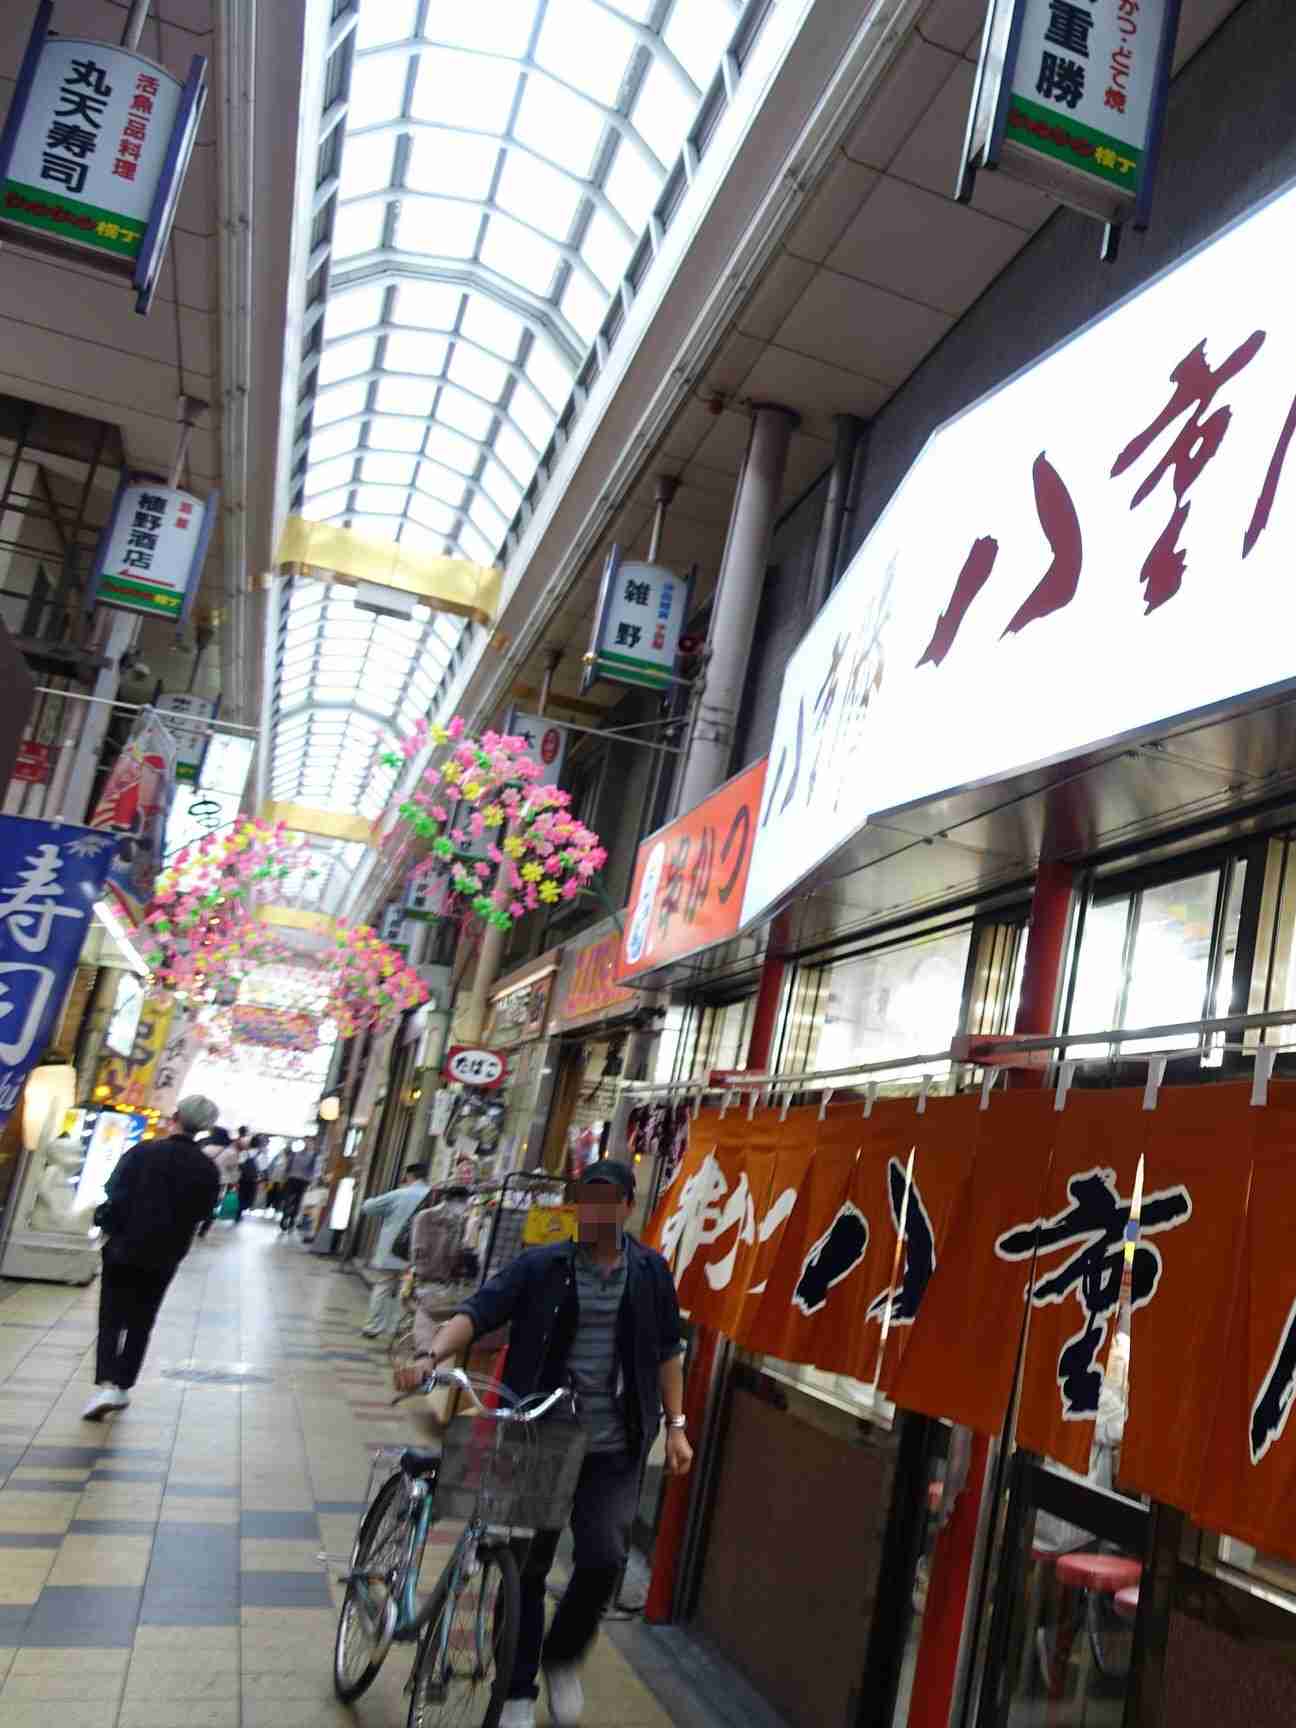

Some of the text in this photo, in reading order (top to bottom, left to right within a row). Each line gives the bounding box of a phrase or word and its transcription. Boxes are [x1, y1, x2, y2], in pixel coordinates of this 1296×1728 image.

[1034, 0, 1096, 110] 重勝
[40, 58, 113, 194] 丸天寿司
[454, 1056, 498, 1078] たばこ
